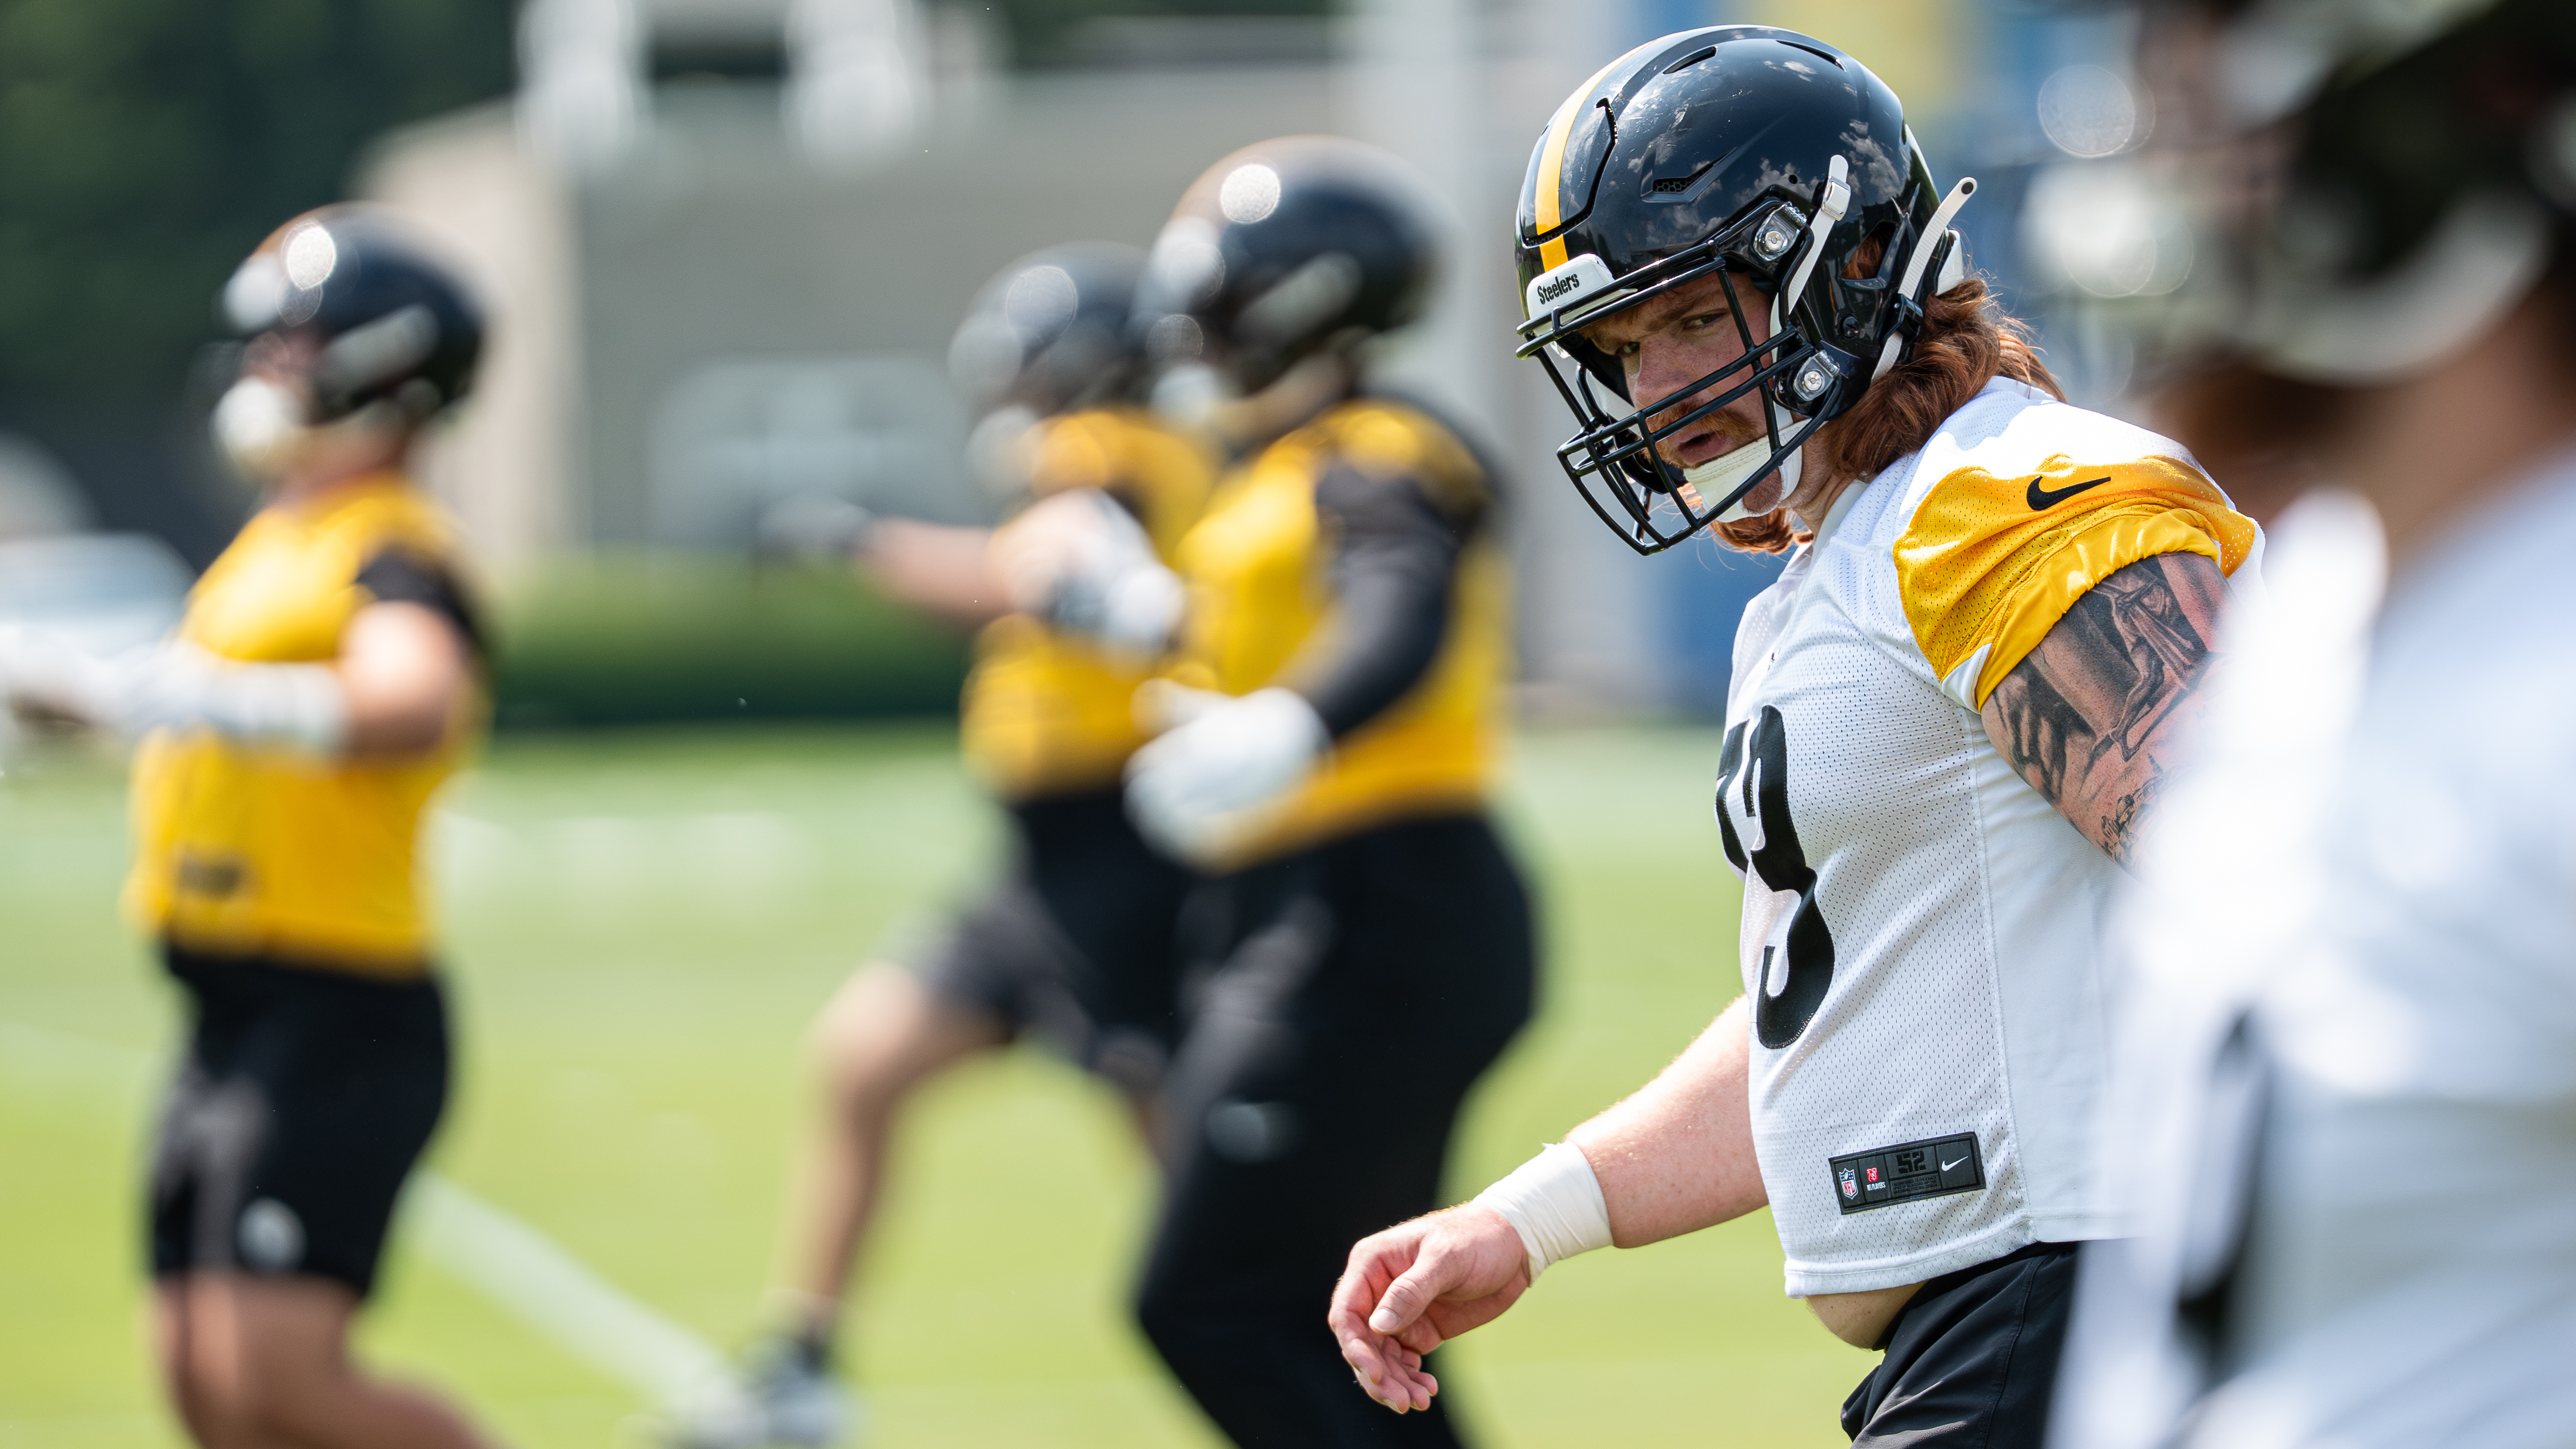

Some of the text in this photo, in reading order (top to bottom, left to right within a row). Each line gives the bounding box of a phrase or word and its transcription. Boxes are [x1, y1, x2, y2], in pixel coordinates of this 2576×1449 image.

[1537, 273, 1579, 305] Steelers
[1896, 1150, 1926, 1174] 52
[1844, 1181, 1855, 1194] NFL
